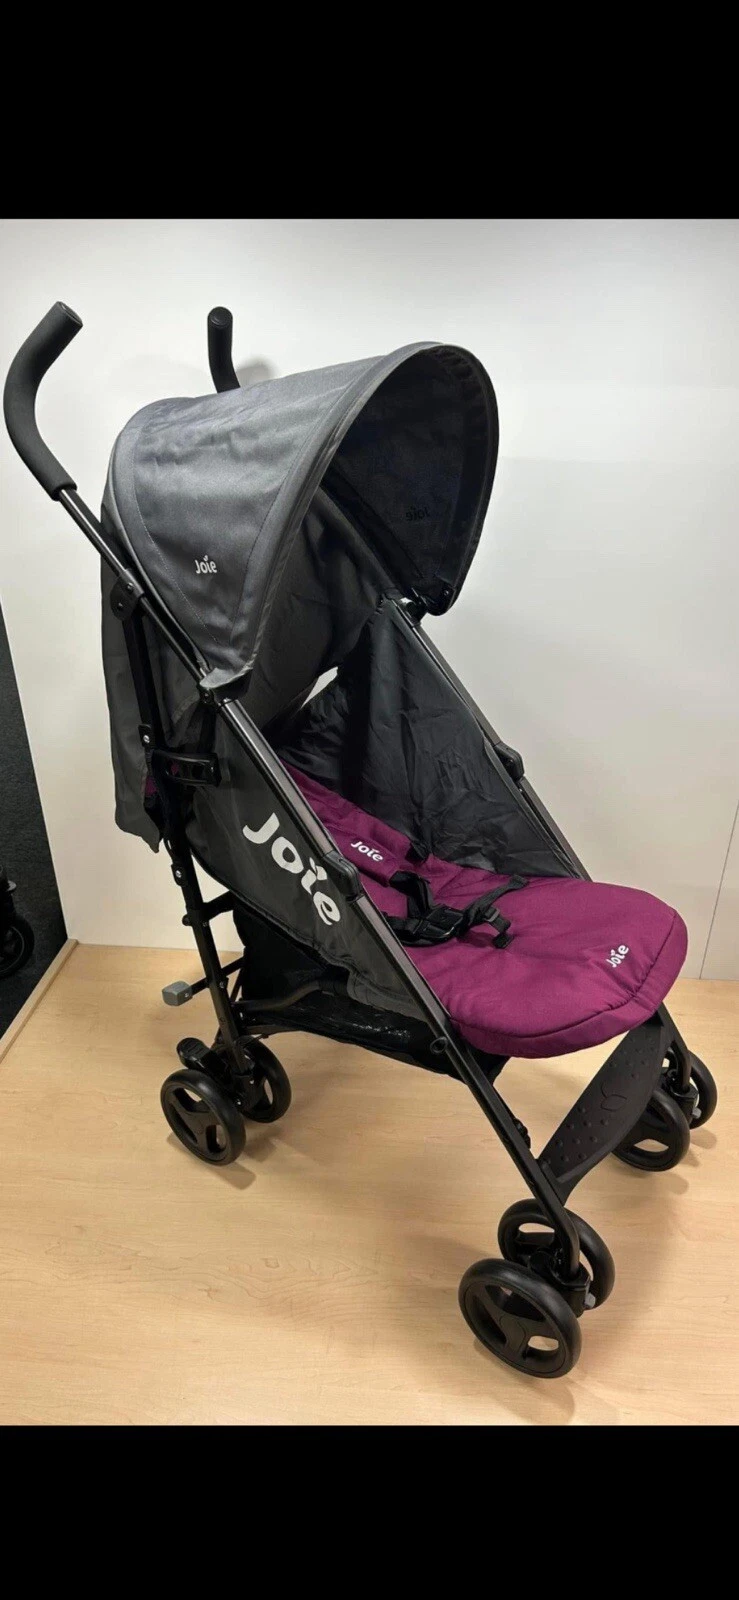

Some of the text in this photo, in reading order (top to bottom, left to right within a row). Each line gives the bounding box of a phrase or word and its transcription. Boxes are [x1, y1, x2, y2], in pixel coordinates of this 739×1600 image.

[194, 554, 218, 574] Joie
[350, 841, 384, 861] Joie
[242, 812, 341, 926] Joie
[605, 944, 629, 968] Joie
